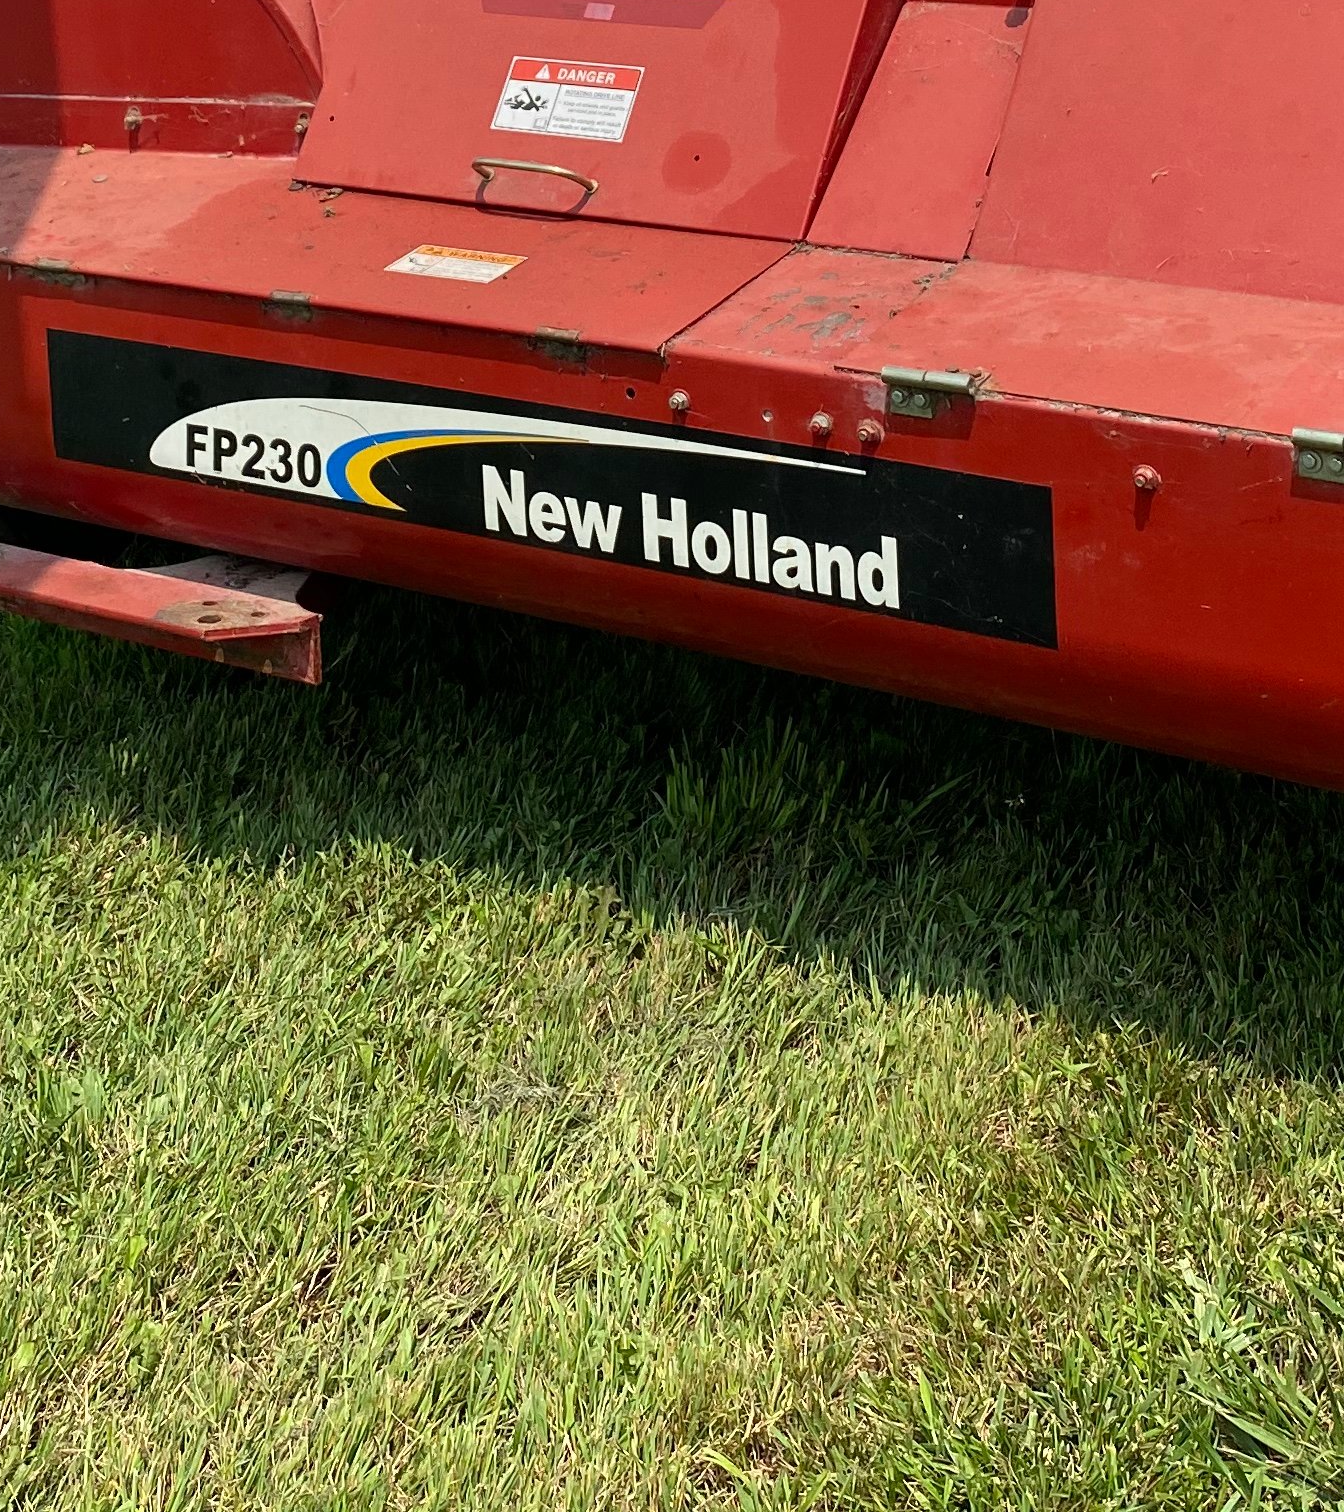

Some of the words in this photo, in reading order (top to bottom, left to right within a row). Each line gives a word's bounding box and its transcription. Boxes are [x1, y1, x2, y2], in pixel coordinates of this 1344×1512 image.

[557, 68, 616, 85] DANGER
[184, 422, 323, 489] FP230
[481, 463, 622, 554] New
[641, 491, 900, 610] Holland
